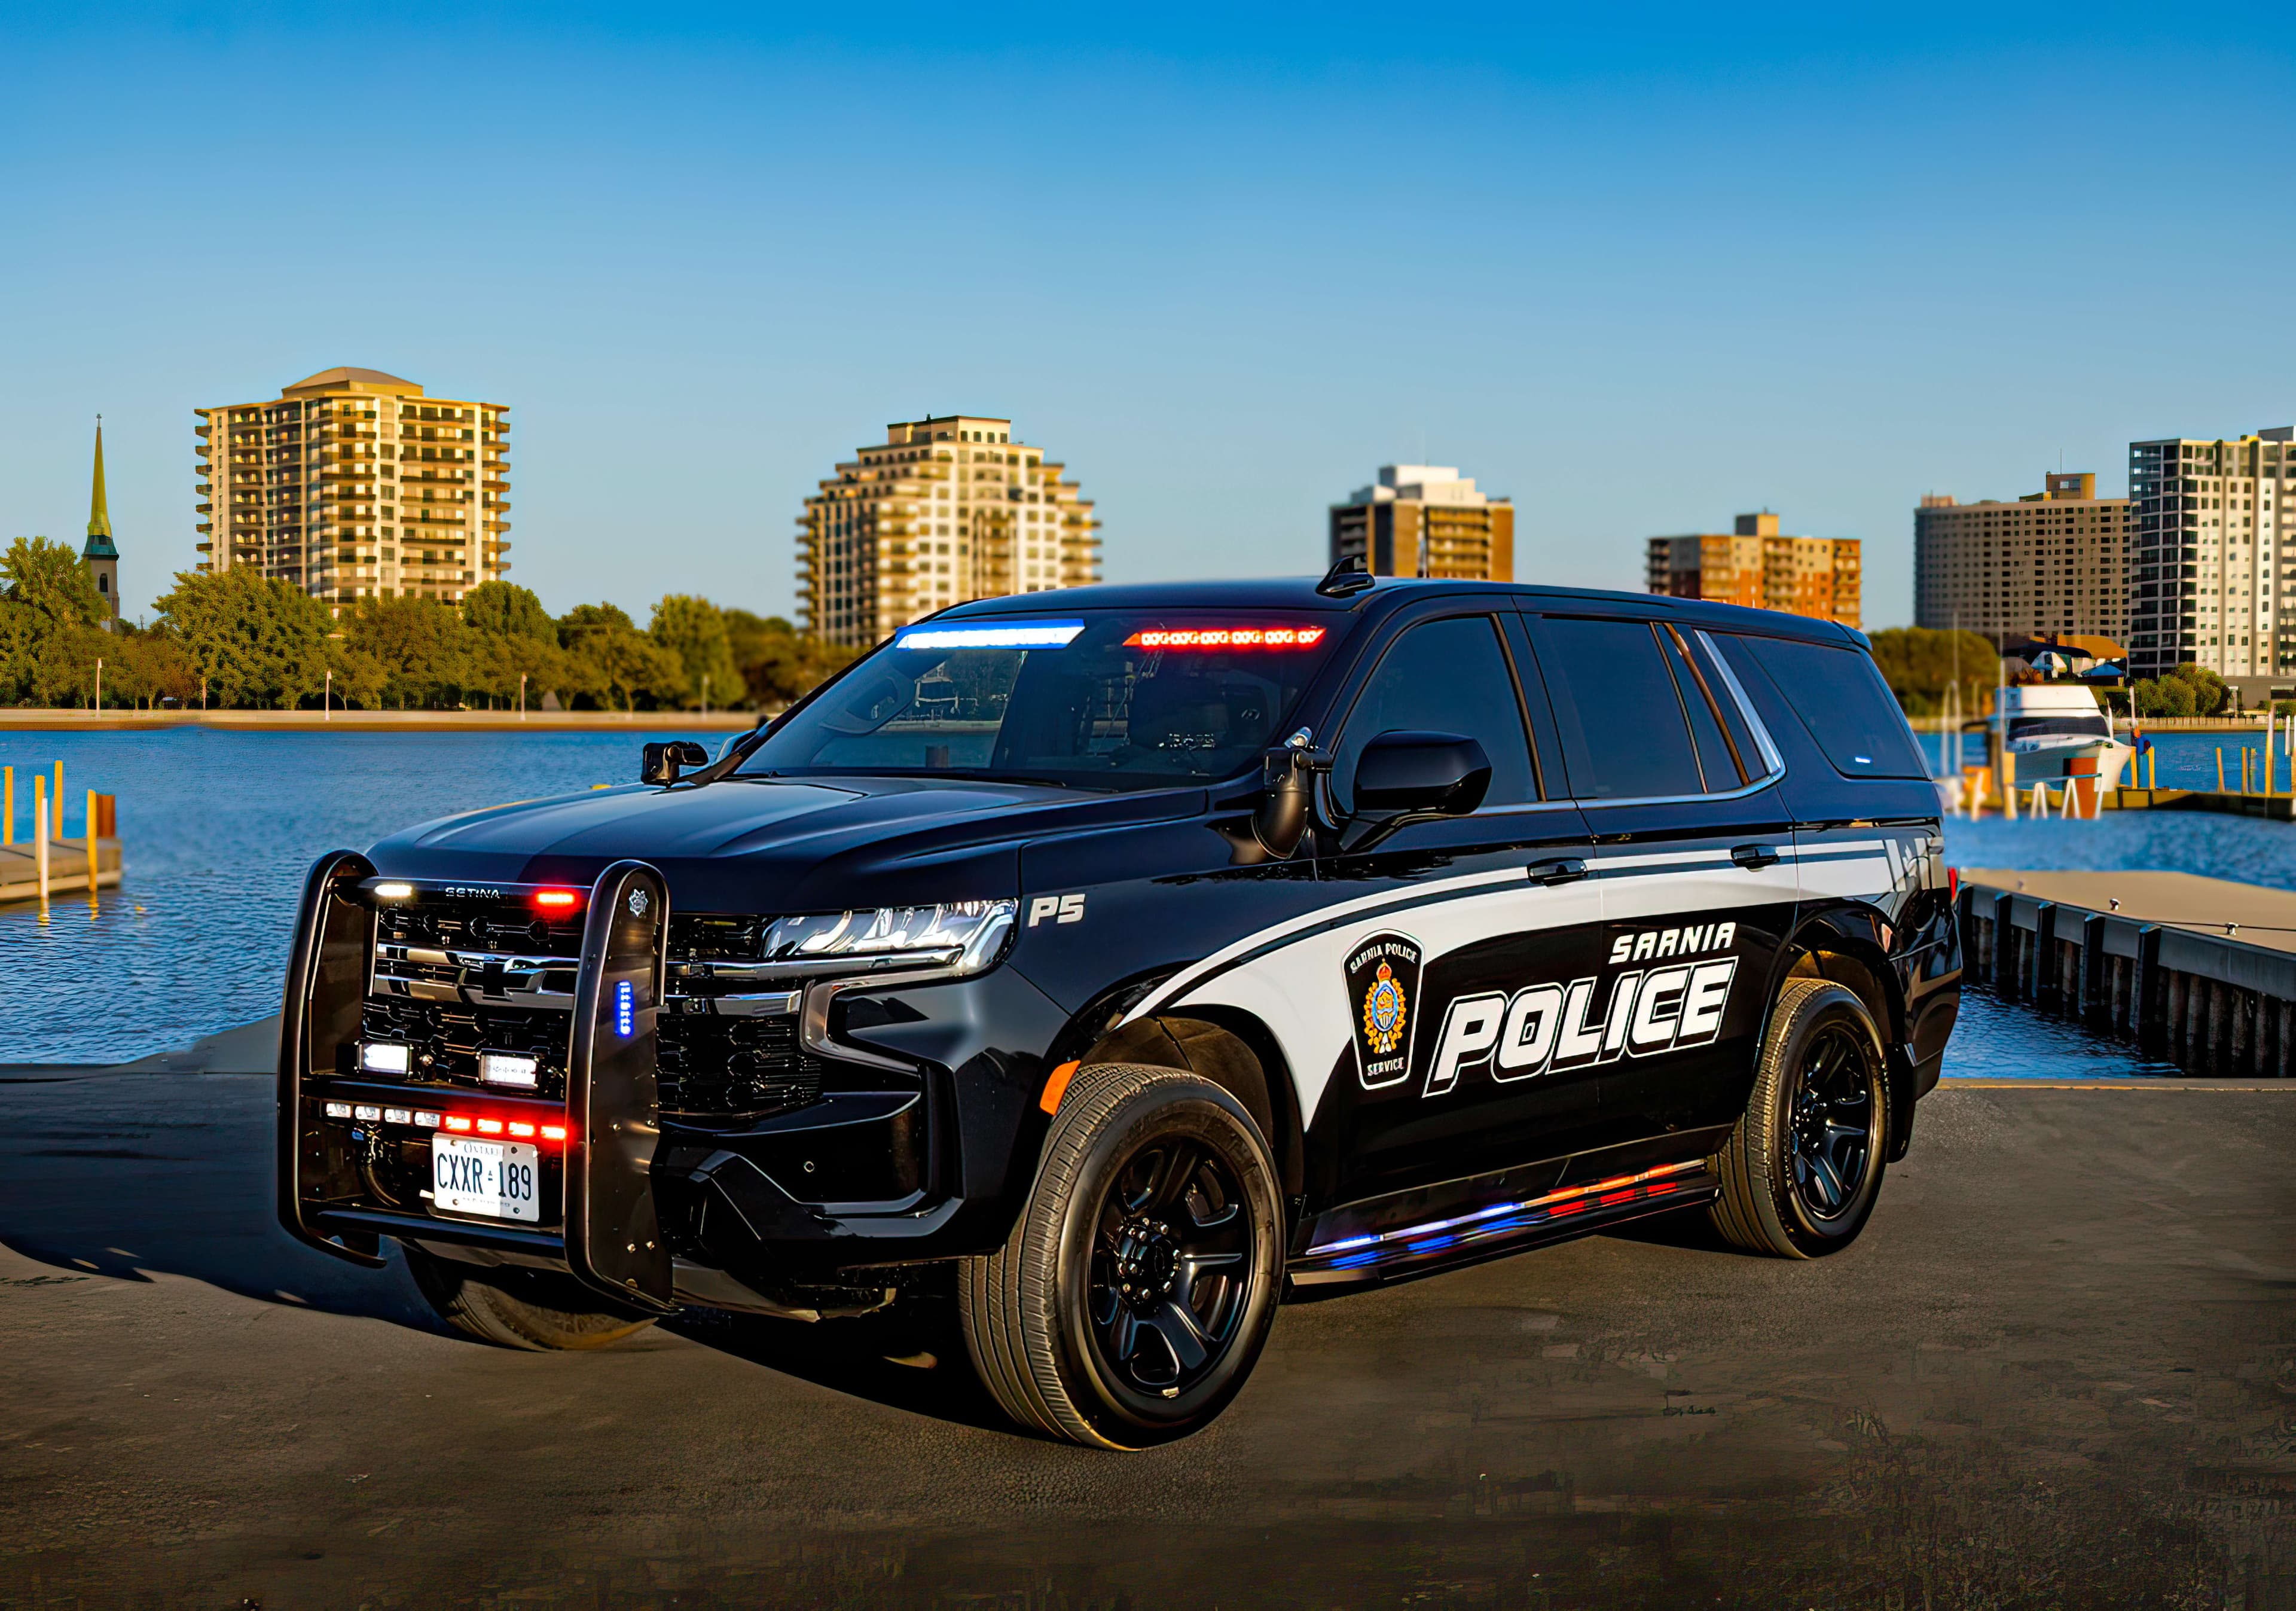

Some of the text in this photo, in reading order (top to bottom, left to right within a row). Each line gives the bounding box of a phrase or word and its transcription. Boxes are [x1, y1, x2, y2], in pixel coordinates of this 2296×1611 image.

[445, 887, 500, 899] SETINA
[1349, 942, 1418, 974] SARNIA POLICE
[1608, 922, 1736, 964] SARNIA
[1421, 956, 1739, 1098] POLICE
[1367, 1057, 1405, 1076] SERVICE
[437, 1152, 532, 1201] CXXR 189
